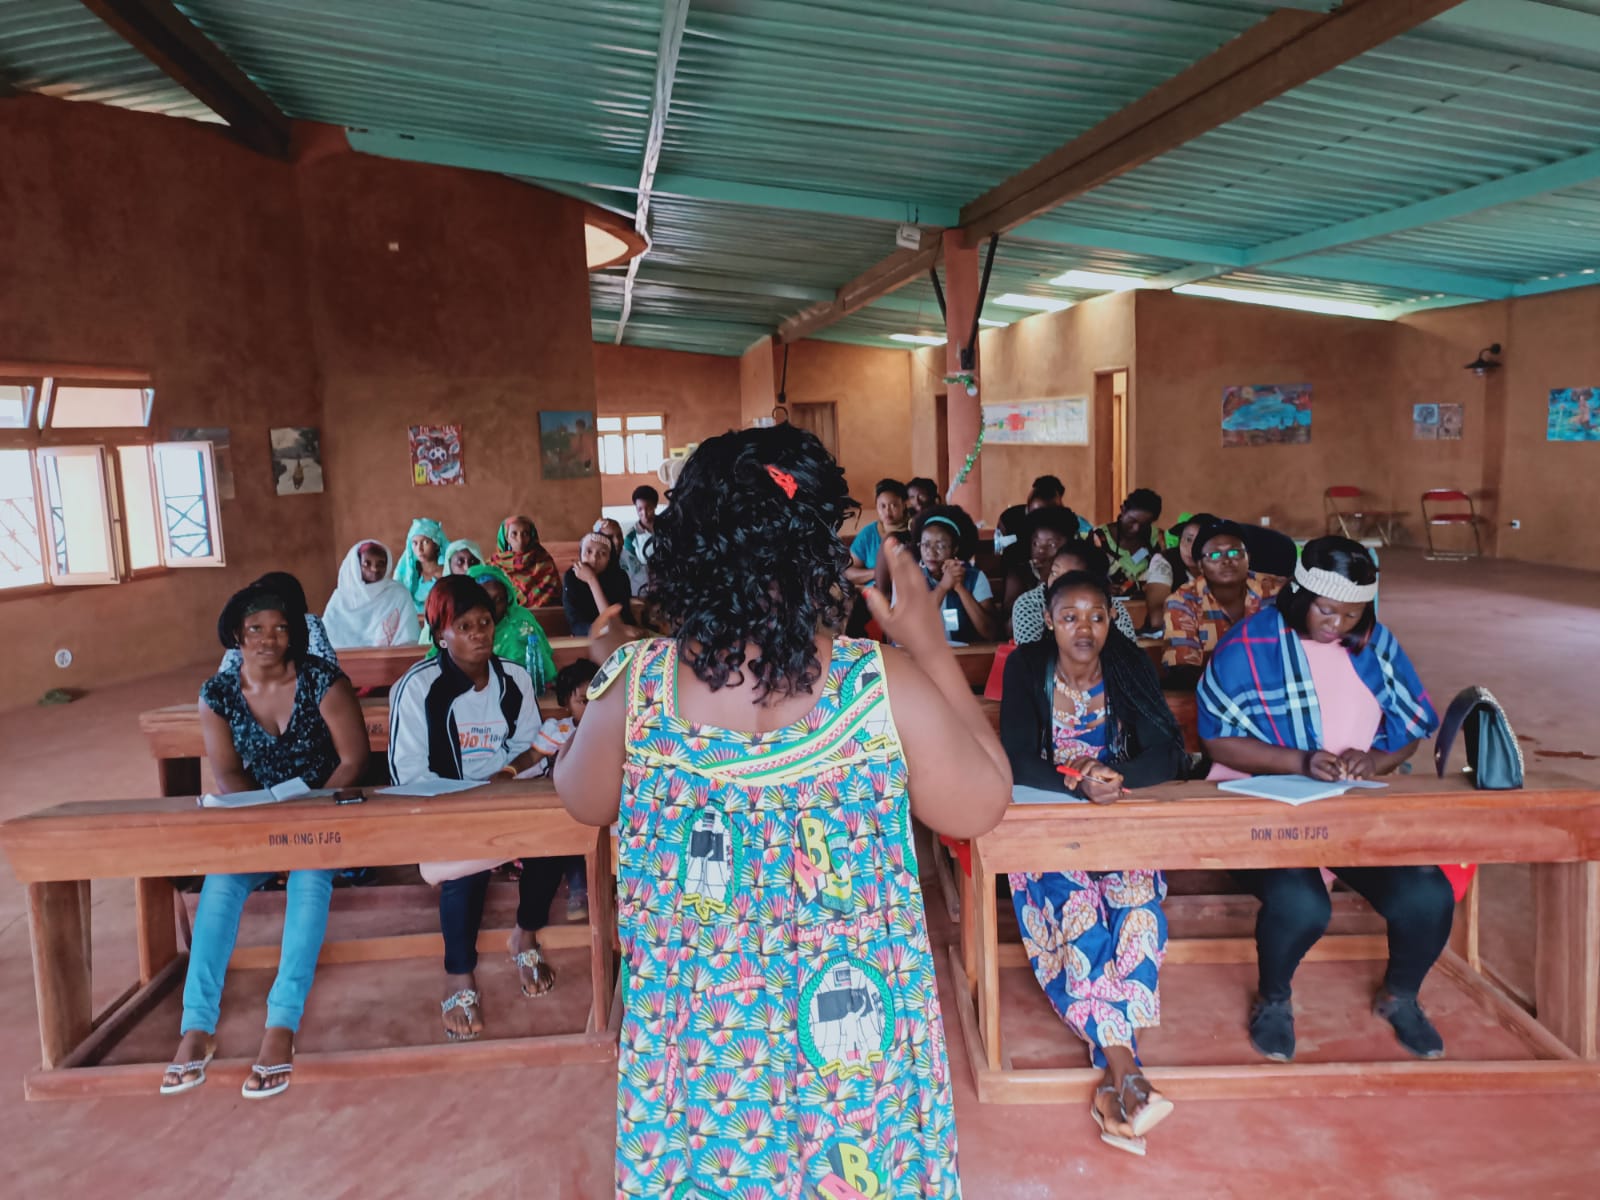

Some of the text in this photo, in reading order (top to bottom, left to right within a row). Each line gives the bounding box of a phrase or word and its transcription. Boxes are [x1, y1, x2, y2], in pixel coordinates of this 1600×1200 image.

[268, 831, 342, 847] DON ONG FJFG
[1251, 826, 1329, 841] DON ONG FJFG
